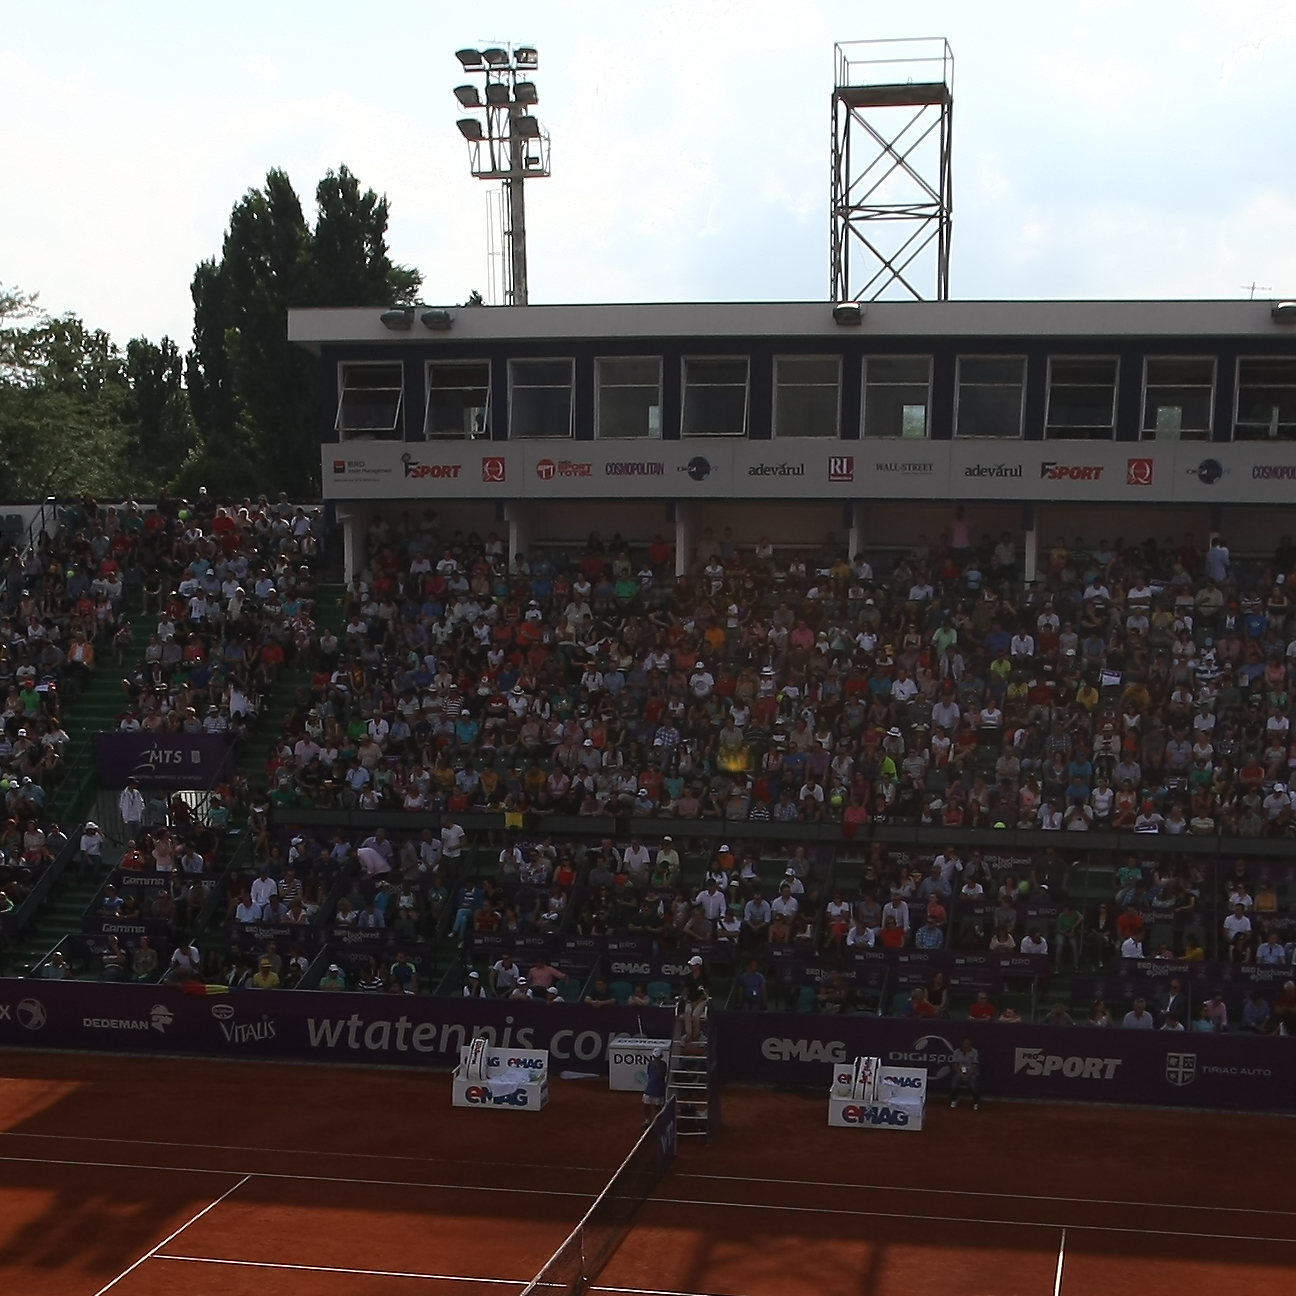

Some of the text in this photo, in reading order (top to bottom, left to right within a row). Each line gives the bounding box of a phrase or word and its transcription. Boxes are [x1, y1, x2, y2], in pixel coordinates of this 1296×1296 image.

[605, 462, 665, 476] COSMOPOLITAN
[611, 962, 692, 976] eMAG eMA
[82, 1017, 149, 1030] DEDEMAN
[760, 1036, 847, 1064] eMAG
[1026, 1053, 1123, 1080] SPORT
[1201, 1064, 1272, 1077] TIRIAC AUTO
[841, 1105, 909, 1126] eMAG
